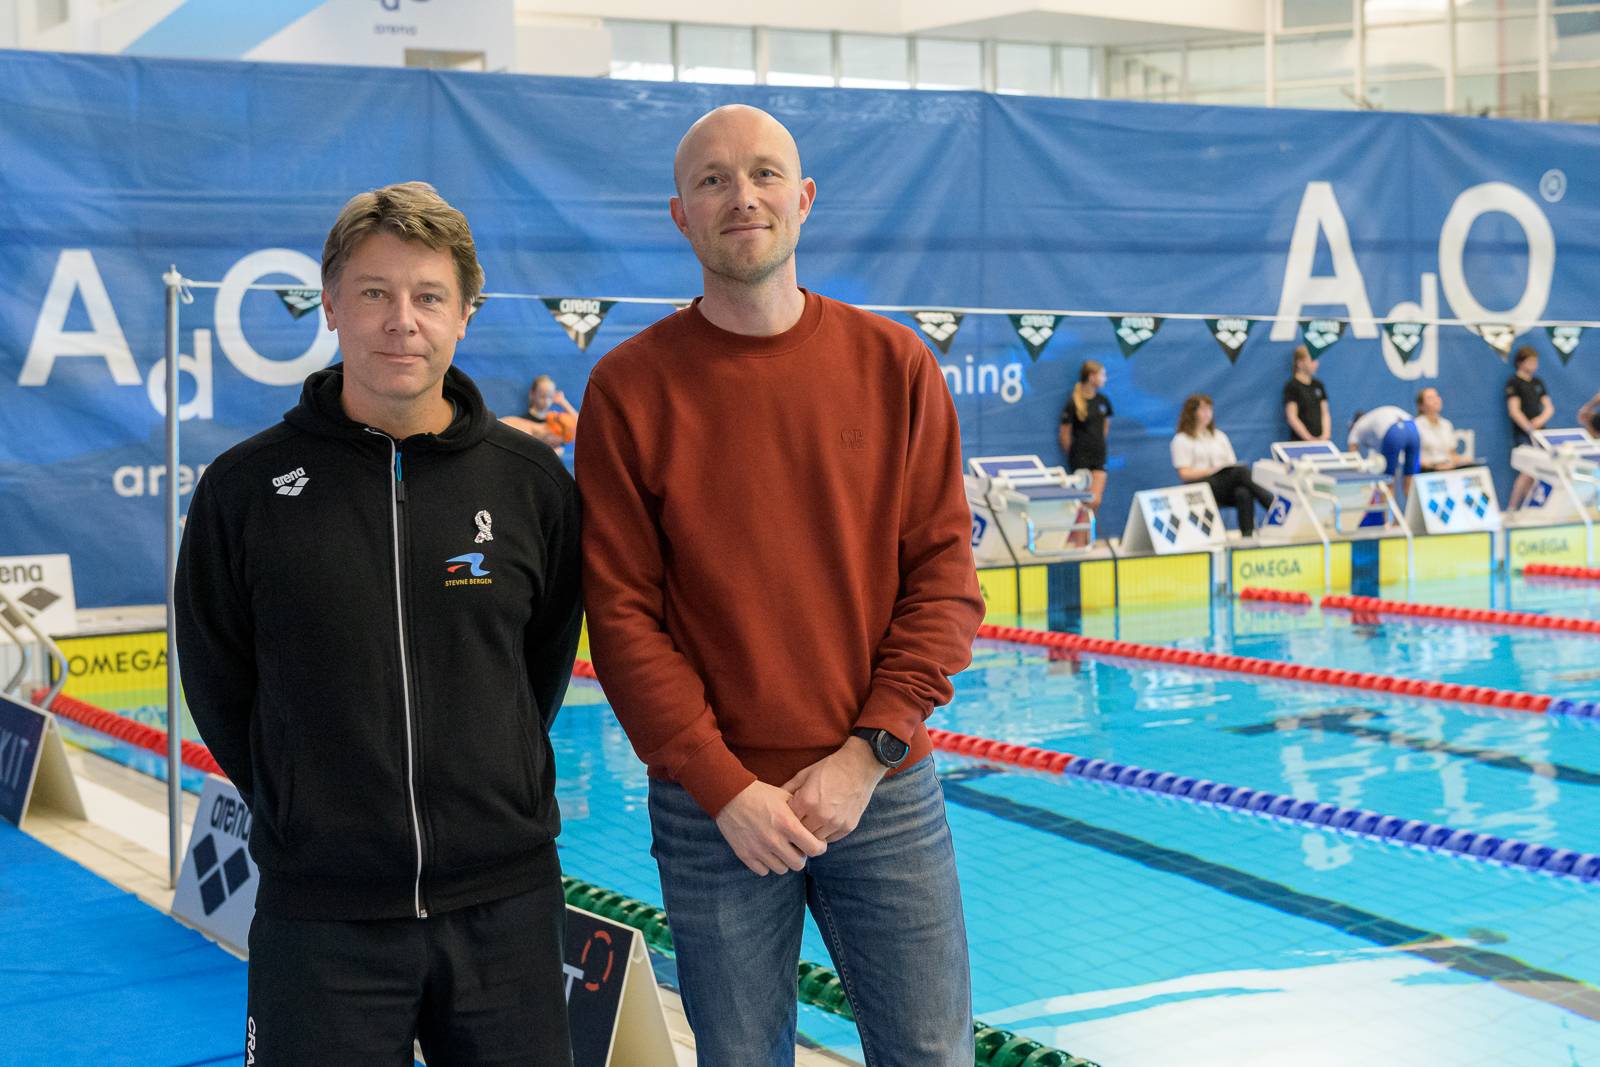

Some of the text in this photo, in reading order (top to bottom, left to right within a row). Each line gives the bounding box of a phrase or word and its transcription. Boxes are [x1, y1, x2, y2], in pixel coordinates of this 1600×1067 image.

[559, 299, 601, 314] arena
[272, 467, 306, 487] arena
[1240, 559, 1302, 579] OMEGA
[445, 579, 468, 587] STEVNE
[68, 650, 168, 677] OMEGA
[247, 1016, 256, 1067] CRA
